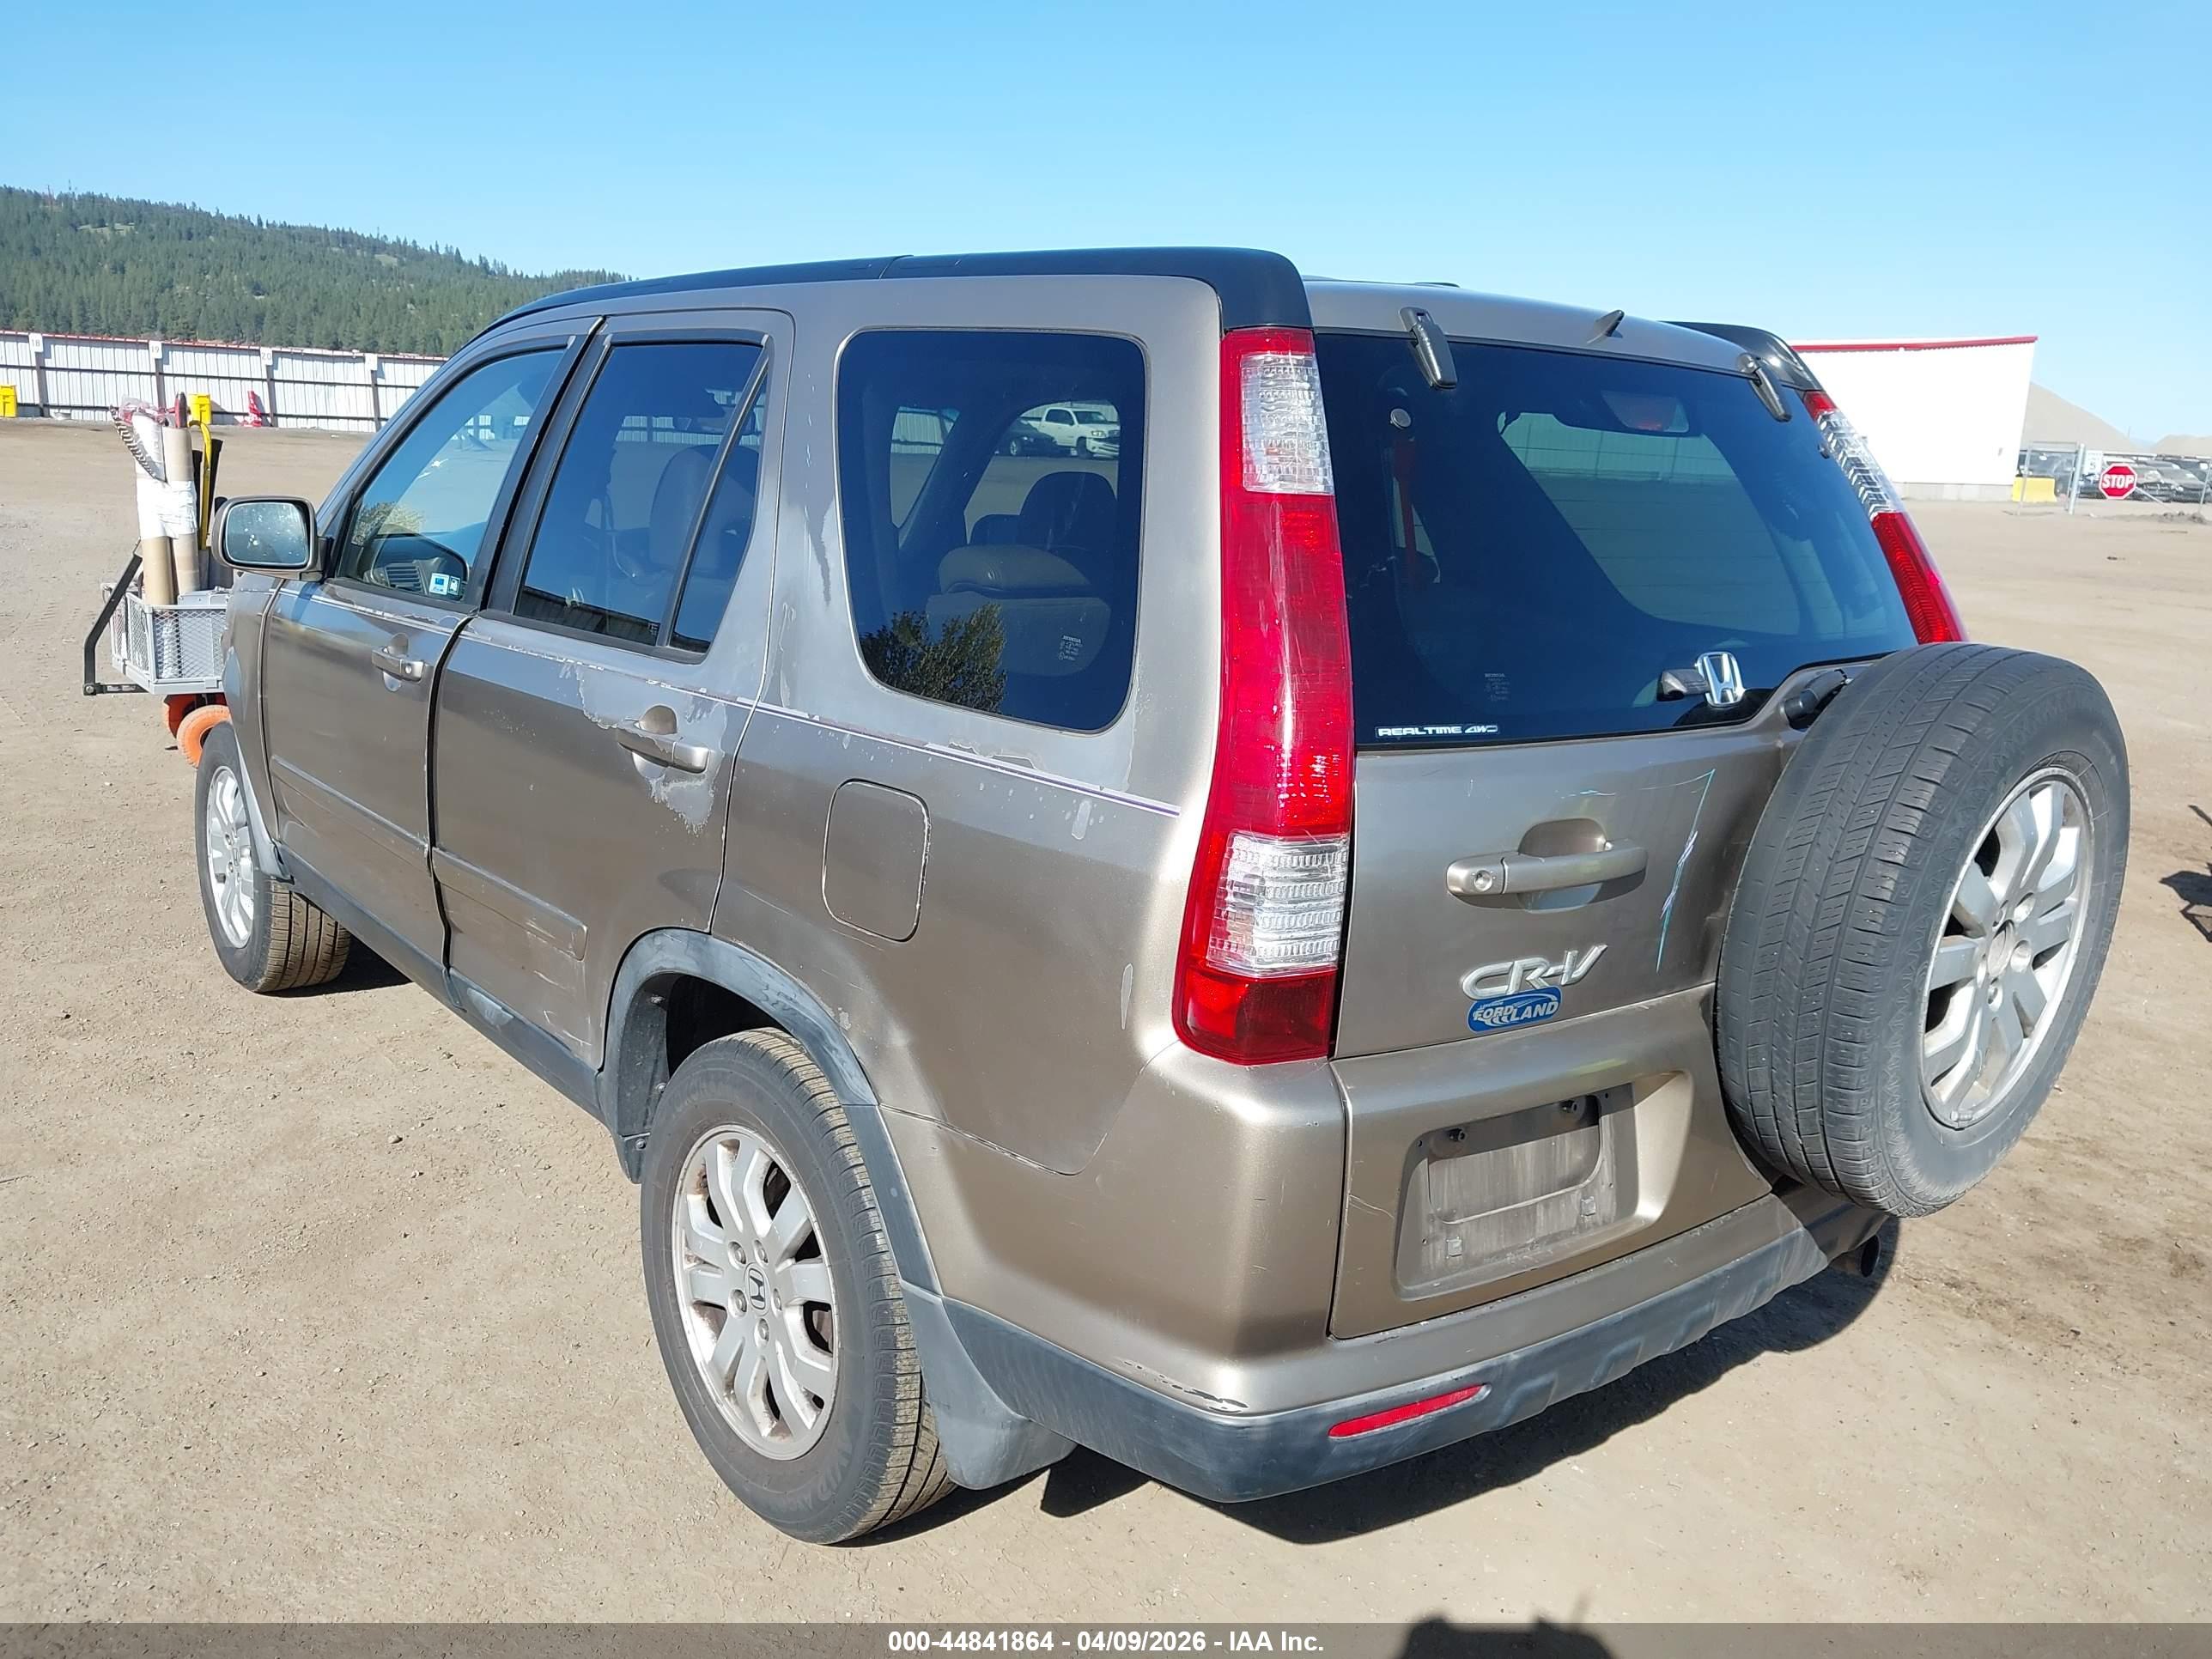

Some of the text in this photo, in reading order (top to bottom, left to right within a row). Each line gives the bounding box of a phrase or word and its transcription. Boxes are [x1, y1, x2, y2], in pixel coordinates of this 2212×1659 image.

[31, 338, 40, 348] 18
[150, 345, 160, 354] 19
[2102, 473, 2135, 489] STOP
[1462, 944, 1608, 1000] CR-V
